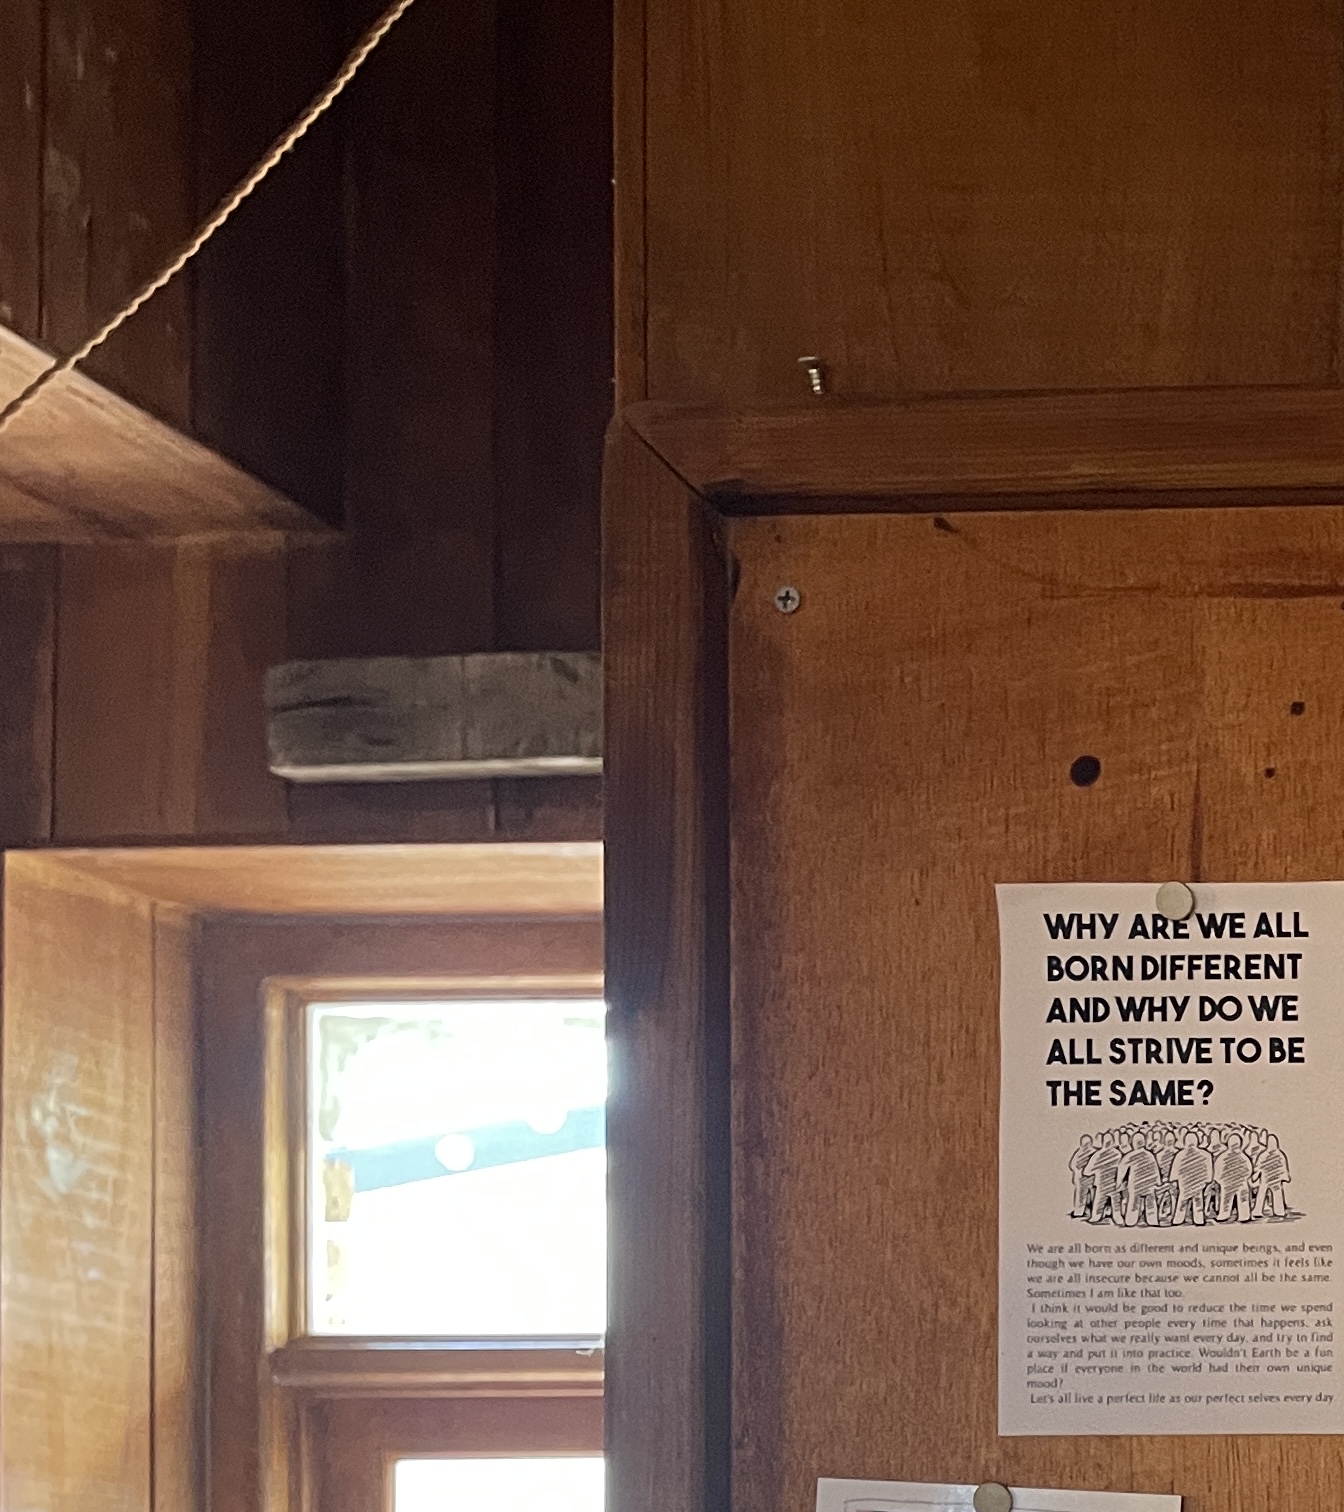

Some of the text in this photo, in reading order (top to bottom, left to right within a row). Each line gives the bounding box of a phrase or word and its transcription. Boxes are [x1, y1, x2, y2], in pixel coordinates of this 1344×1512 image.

[1043, 912, 1309, 940] WHY ARE WE ALL
[1047, 953, 1302, 981] BORN DIFFERENT
[1046, 995, 1298, 1023] AND WHY DO WE
[1046, 1037, 1305, 1065] ALL STRIVE TO BE
[1046, 1080, 1213, 1106] THE SAME?
[1027, 1244, 1043, 1253] We
[1068, 1243, 1081, 1253] all
[1085, 1243, 1111, 1253] born
[1115, 1245, 1126, 1253] as
[1130, 1243, 1174, 1253] different
[1179, 1243, 1198, 1253] and
[1202, 1245, 1238, 1255] unique
[1285, 1242, 1305, 1252] and
[1027, 1288, 1086, 1298] Sometimes
[1118, 1288, 1136, 1298] like
[1140, 1288, 1160, 1298] that
